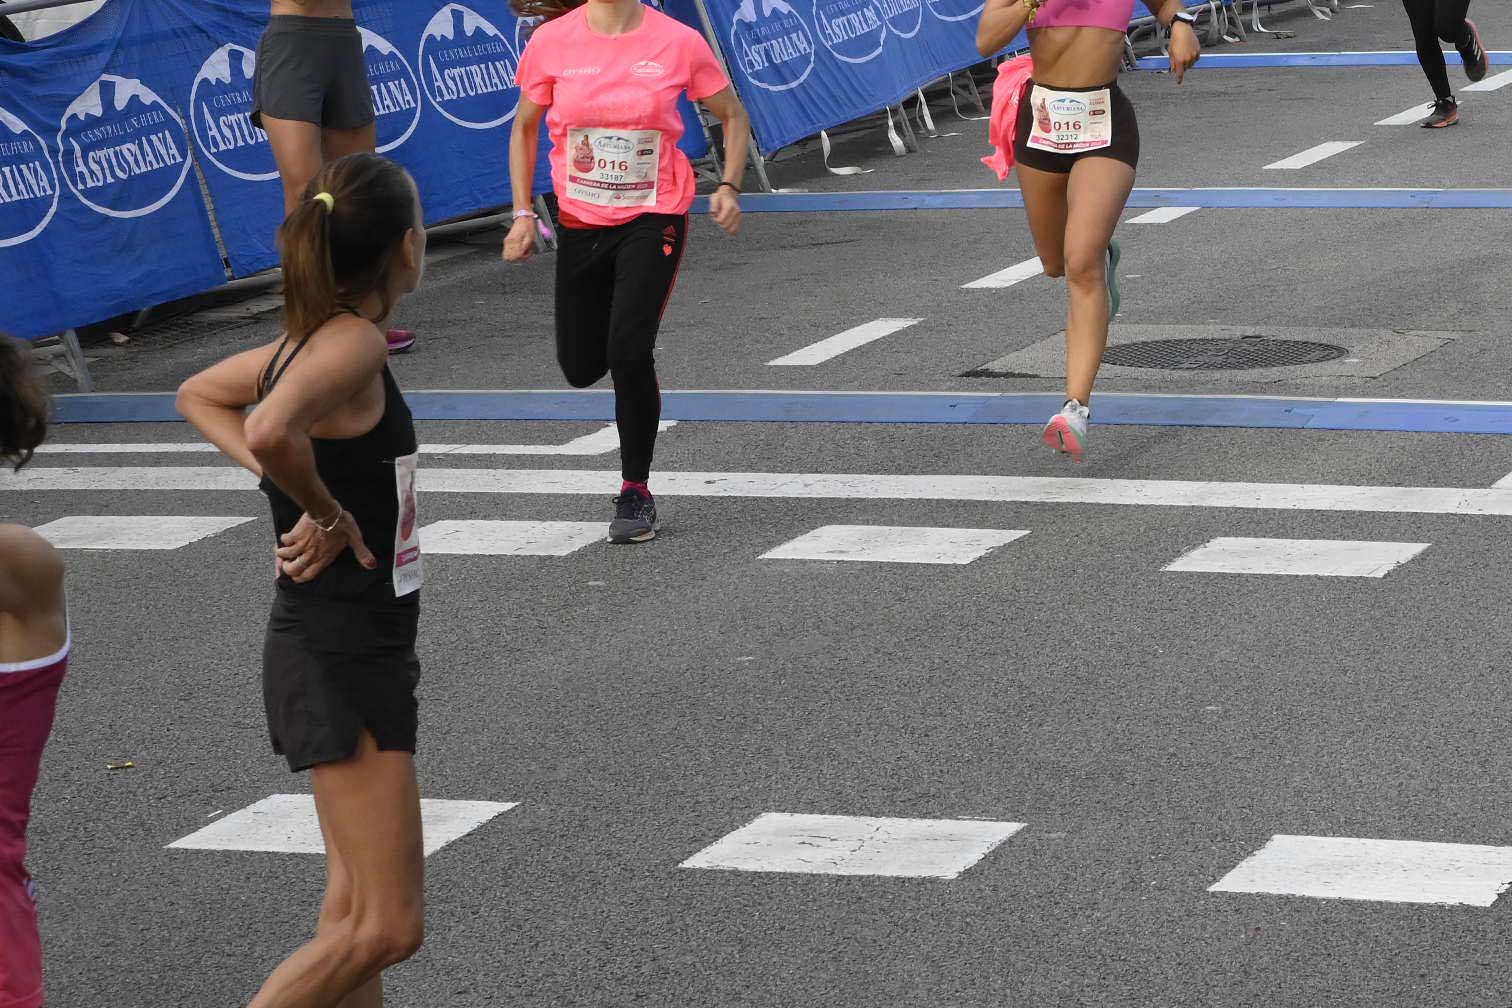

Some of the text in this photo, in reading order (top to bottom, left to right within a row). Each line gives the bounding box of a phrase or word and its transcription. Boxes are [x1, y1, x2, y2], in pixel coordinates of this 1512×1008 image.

[366, 60, 401, 77] ECHERA
[1053, 120, 1082, 131] 016
[597, 158, 629, 172] 016
[600, 173, 625, 182] 33187
